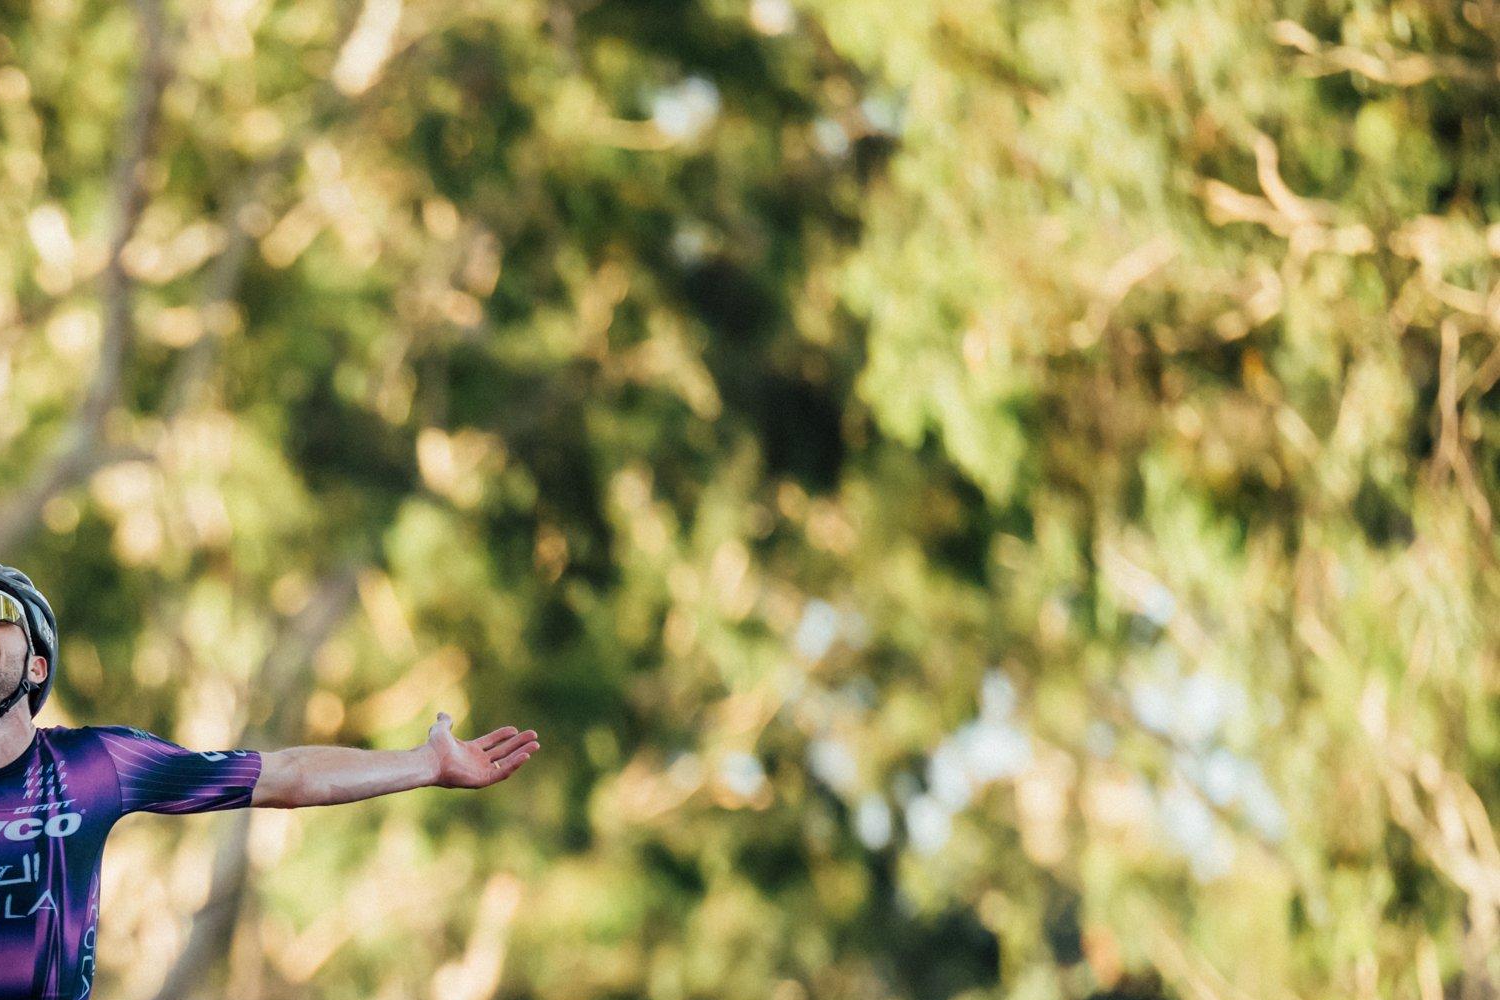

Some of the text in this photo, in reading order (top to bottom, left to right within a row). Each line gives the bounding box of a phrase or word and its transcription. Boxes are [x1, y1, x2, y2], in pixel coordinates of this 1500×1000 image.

[23, 760, 66, 778] MAAP
[23, 772, 67, 788] MAAP
[23, 784, 68, 800] MAAP
[13, 798, 77, 815] GIANT
